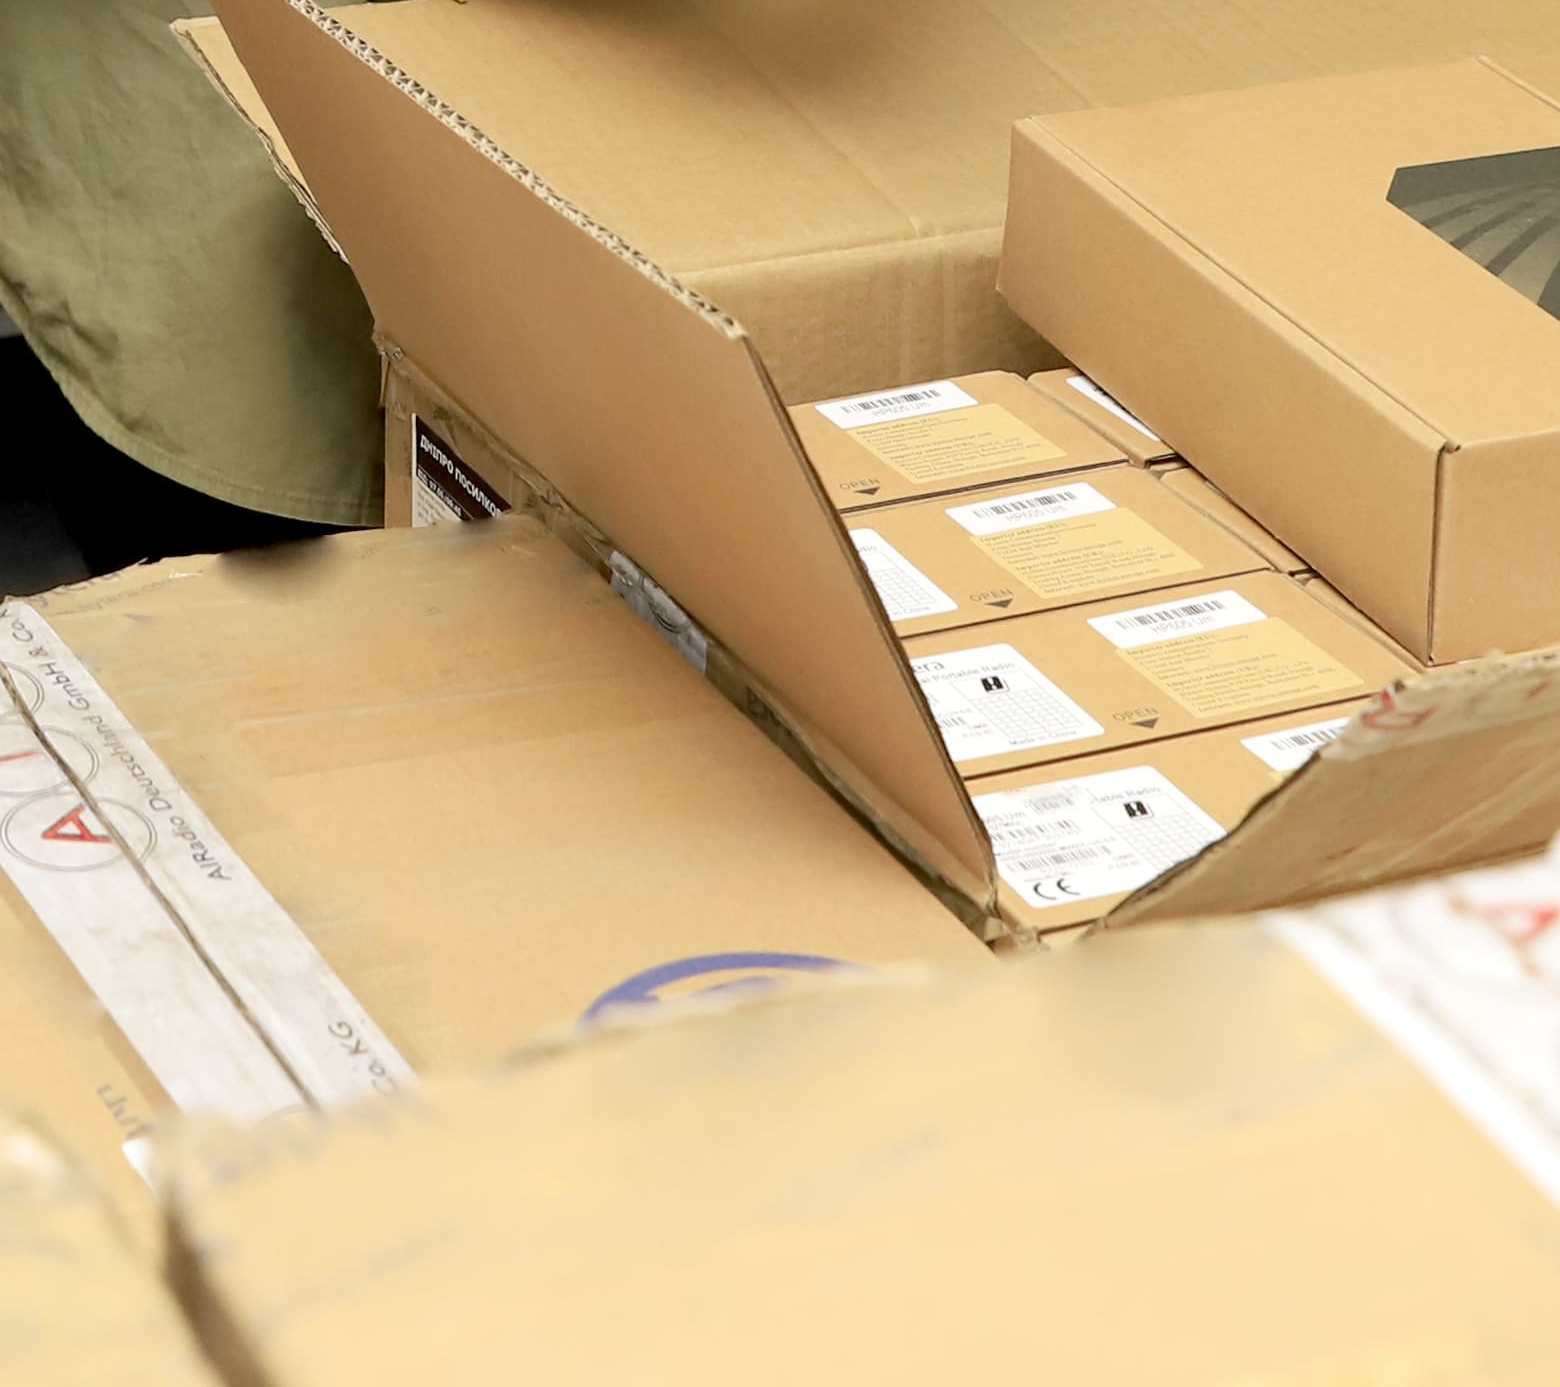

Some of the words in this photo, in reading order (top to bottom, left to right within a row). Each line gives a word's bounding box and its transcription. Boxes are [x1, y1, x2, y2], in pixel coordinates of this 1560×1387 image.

[839, 478, 880, 490] OPEN
[969, 588, 1013, 602] OPEN
[39, 660, 91, 712] GmbH
[1112, 707, 1159, 722] OPEN
[81, 713, 173, 812] Deutschland
[168, 812, 232, 883] AIRadio
[327, 1020, 369, 1057] KG
